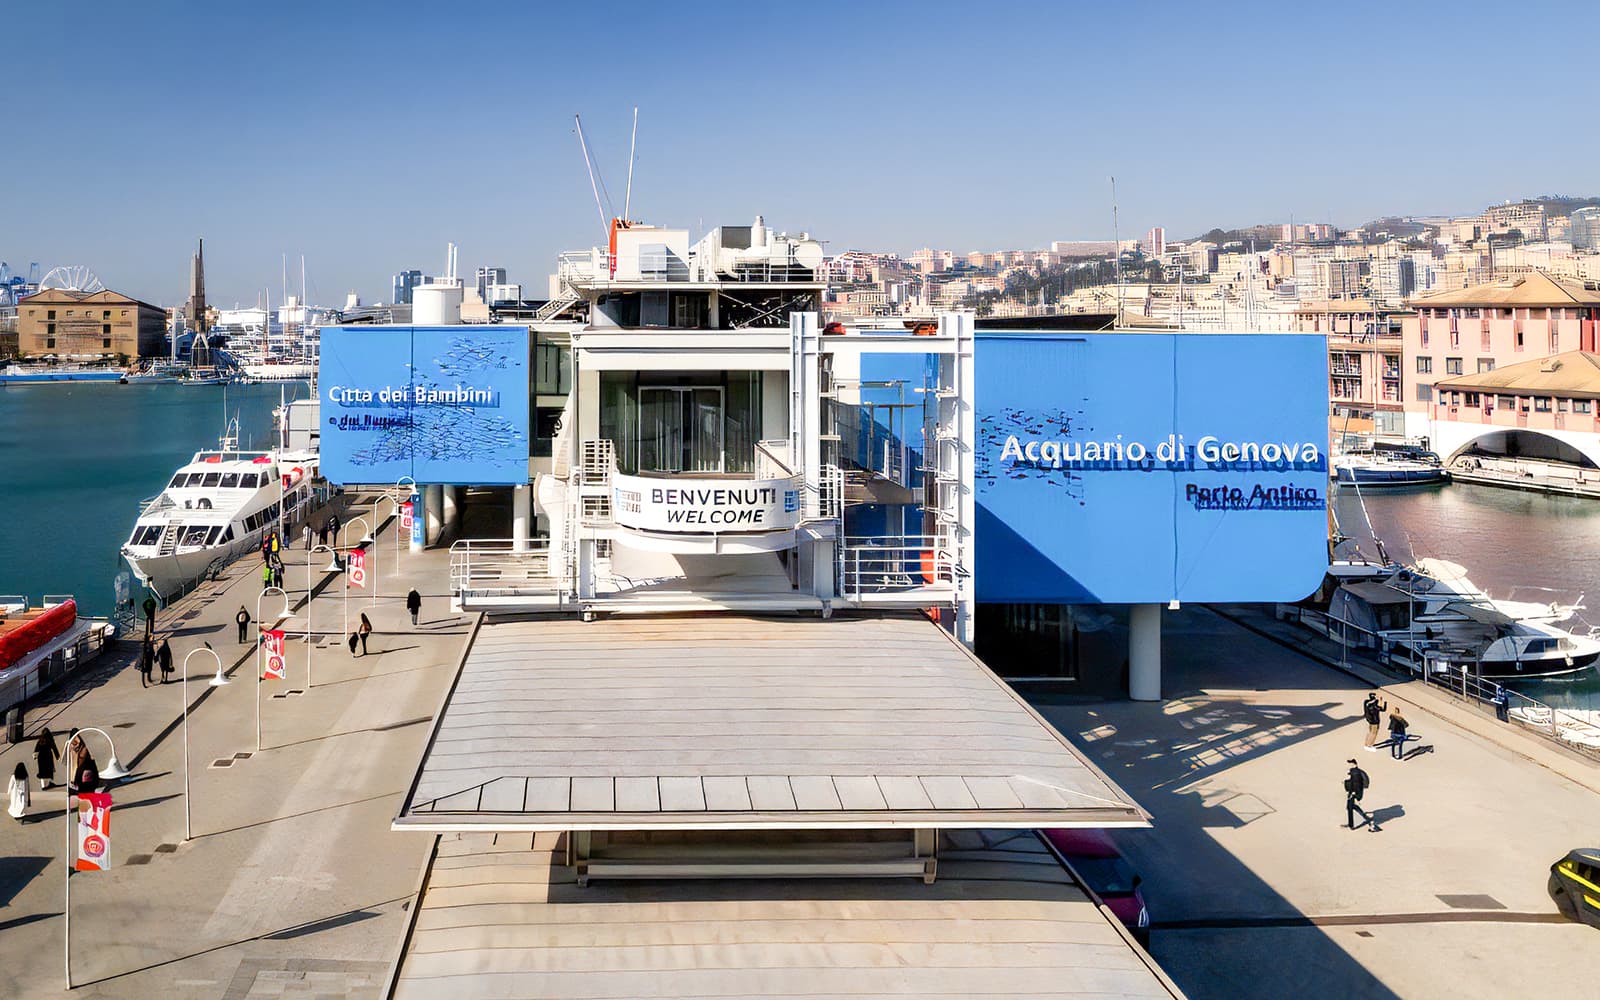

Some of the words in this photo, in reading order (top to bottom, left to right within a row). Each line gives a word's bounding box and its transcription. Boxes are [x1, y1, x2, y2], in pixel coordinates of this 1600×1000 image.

[379, 385, 408, 403] dei
[415, 386, 492, 404] Bambini
[1000, 434, 1146, 468] Acquario
[1157, 434, 1185, 462] di
[1197, 436, 1319, 463] Genova
[667, 509, 765, 524] WELCOME
